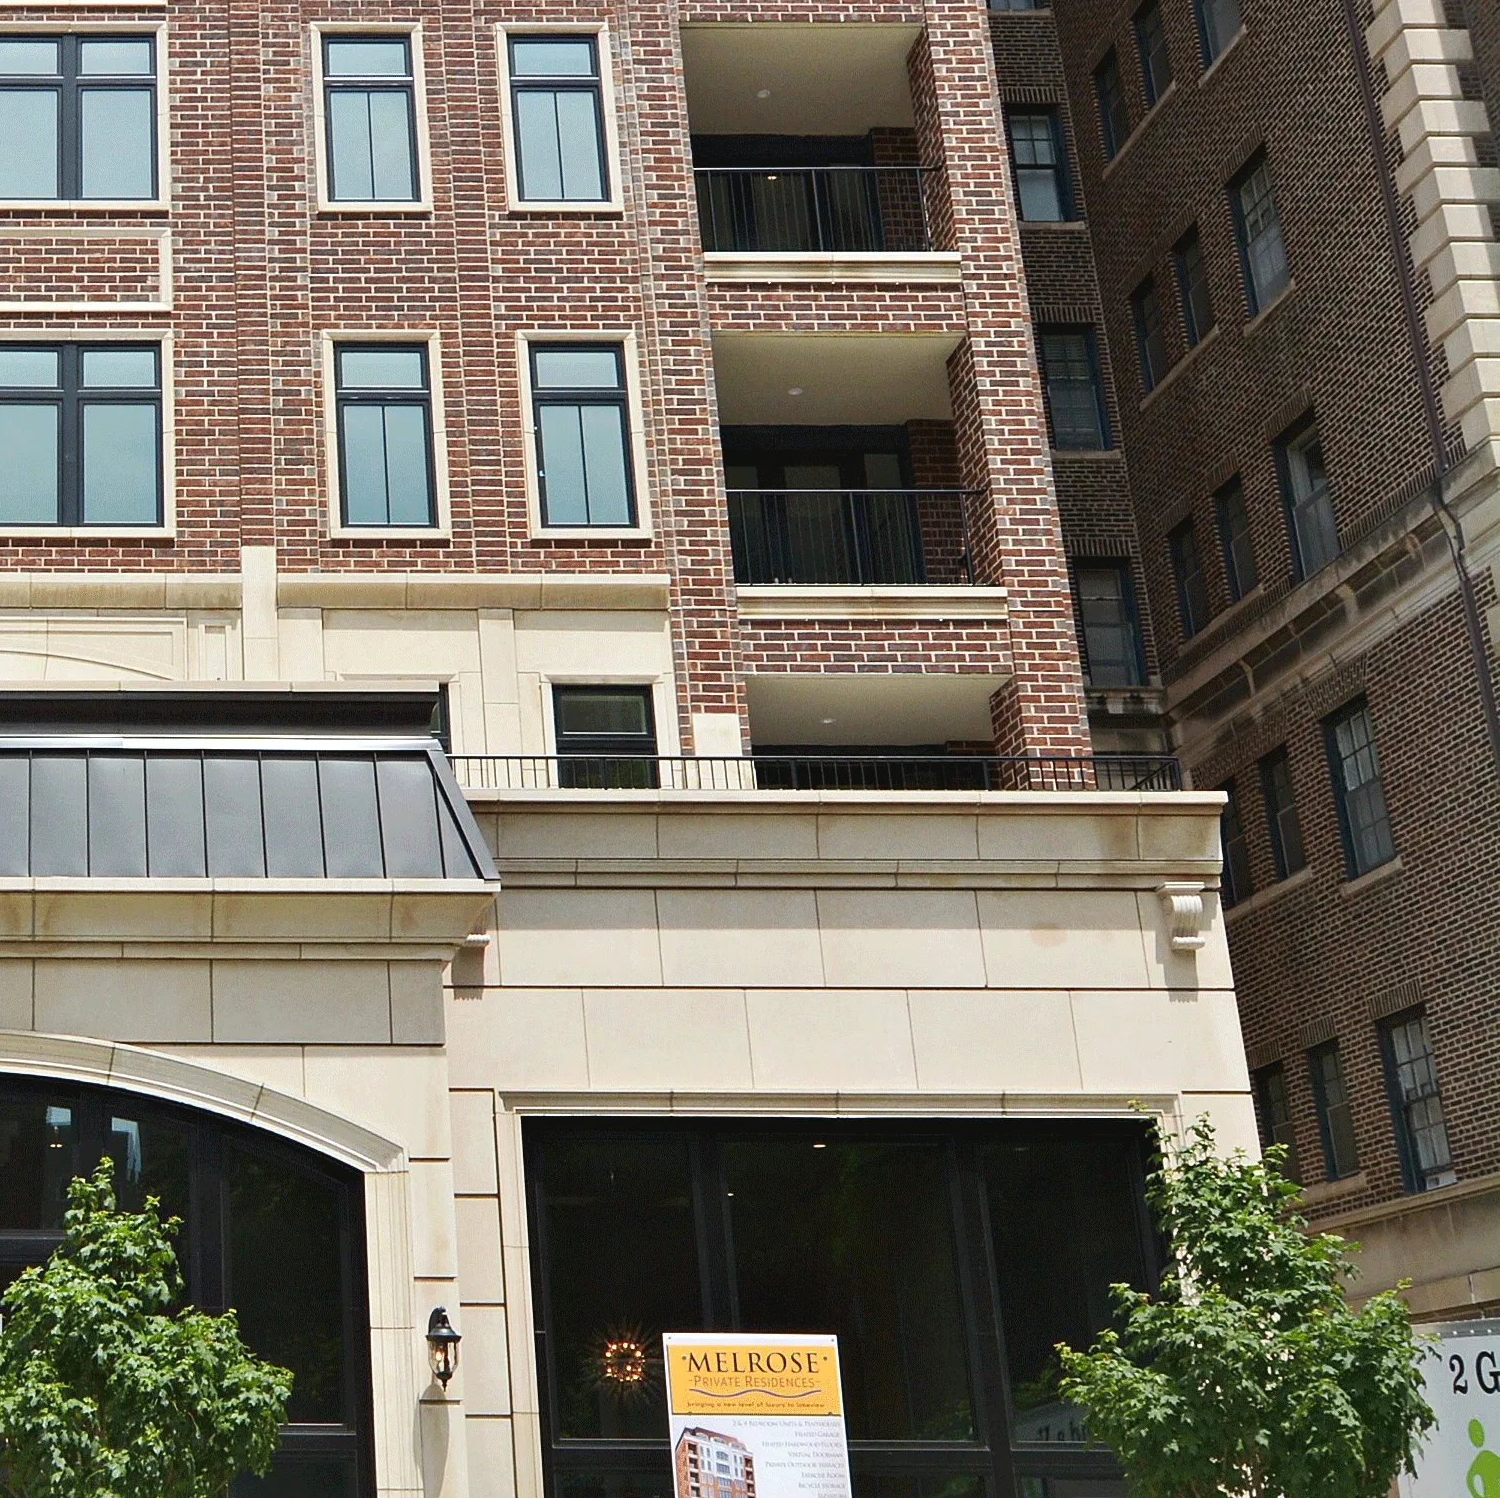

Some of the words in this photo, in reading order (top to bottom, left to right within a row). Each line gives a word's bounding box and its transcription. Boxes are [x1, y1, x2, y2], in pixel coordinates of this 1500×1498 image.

[687, 1351, 820, 1374] MELROSE
[1449, 1354, 1468, 1394] 2
[693, 1375, 741, 1387] PRIVATE
[744, 1375, 815, 1389] RESIDENCES
